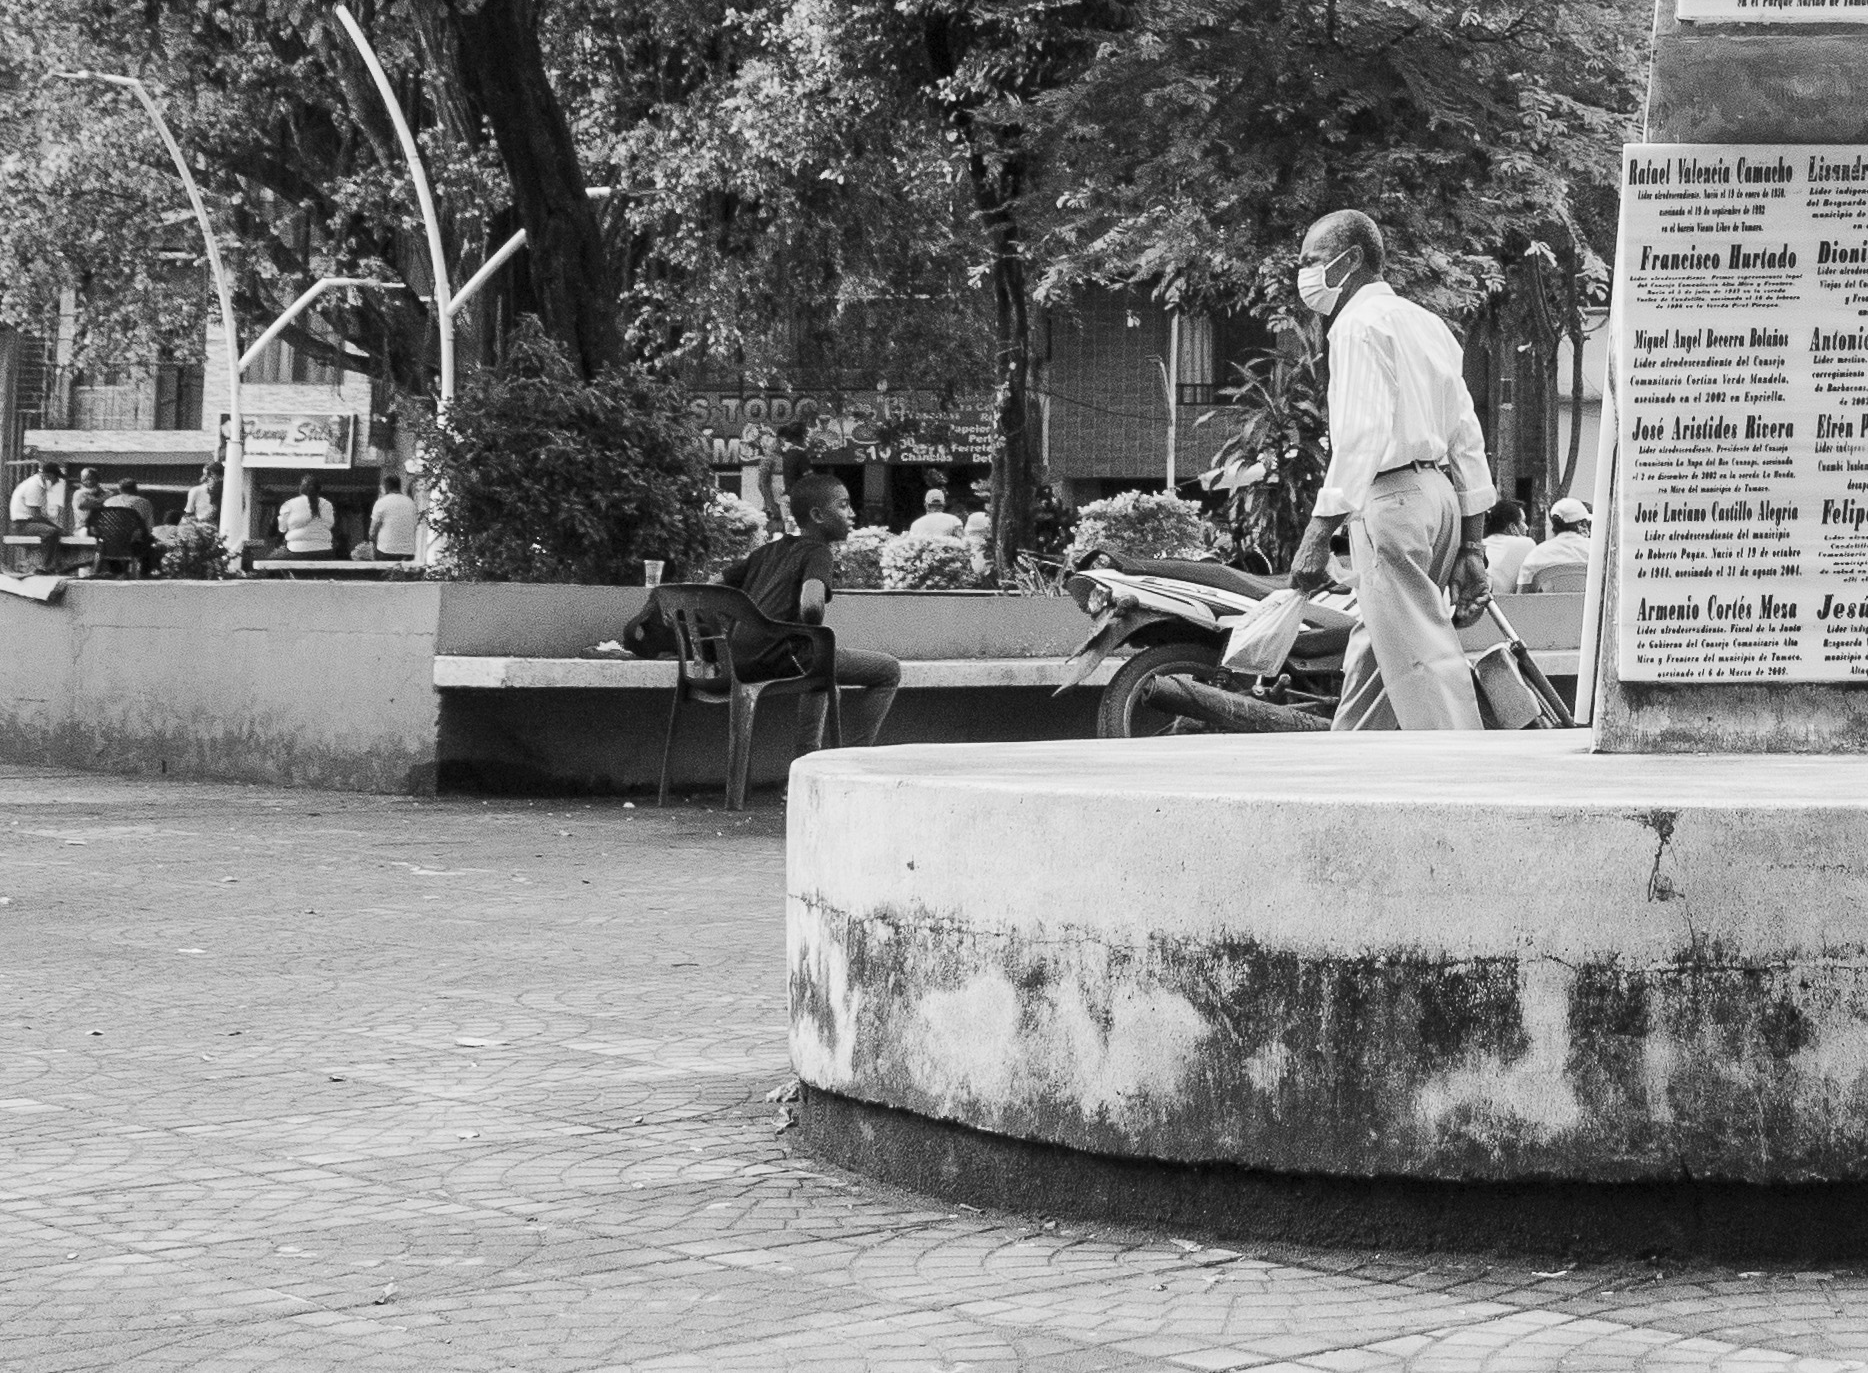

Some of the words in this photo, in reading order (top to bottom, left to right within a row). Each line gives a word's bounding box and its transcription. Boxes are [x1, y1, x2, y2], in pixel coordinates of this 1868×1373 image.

[1629, 158, 1671, 185] Rafael
[1678, 157, 1730, 184] Valencia
[1737, 156, 1793, 184] Camacho
[1640, 244, 1720, 271] Francisco
[1728, 243, 1796, 270] Hurtado
[1634, 329, 1669, 355] Miguel
[1706, 328, 1745, 348] Becerra
[1749, 327, 1789, 347] Bolaños
[1736, 356, 1750, 367] del
[1753, 355, 1785, 369] Consejo
[1723, 374, 1745, 384] Verde
[1693, 392, 1702, 403] el
[1705, 392, 1726, 403] 2002
[1632, 417, 1664, 441] José
[1671, 415, 1738, 441] Aristides
[1745, 414, 1794, 439] Rivera
[1816, 414, 1853, 439] Efrén
[1634, 502, 1658, 523] José
[1663, 501, 1706, 523] Luciano
[1711, 500, 1752, 522] Castillo
[1757, 500, 1798, 527] Alegría
[1737, 528, 1749, 540] del
[1635, 549, 1643, 560] de
[1647, 548, 1677, 560] Roberto
[1736, 547, 1743, 558] el
[1747, 547, 1756, 558] 19
[1760, 547, 1768, 558] de
[1637, 567, 1647, 578] de
[1716, 566, 1724, 577] el
[1727, 565, 1736, 577] 31
[1740, 565, 1749, 577] de
[1637, 595, 1699, 621] Armenio
[1707, 595, 1752, 621] Cortés
[1756, 624, 1765, 633] de
[1768, 623, 1776, 632] la
[1637, 641, 1645, 649] de
[1686, 639, 1698, 648] del
[1701, 639, 1729, 650] Consejo
[1658, 658, 1662, 666] y
[1703, 653, 1715, 662] del
[1759, 653, 1767, 661] de
[1698, 668, 1705, 677] el
[1716, 668, 1724, 677] de
[1756, 667, 1764, 675] de
